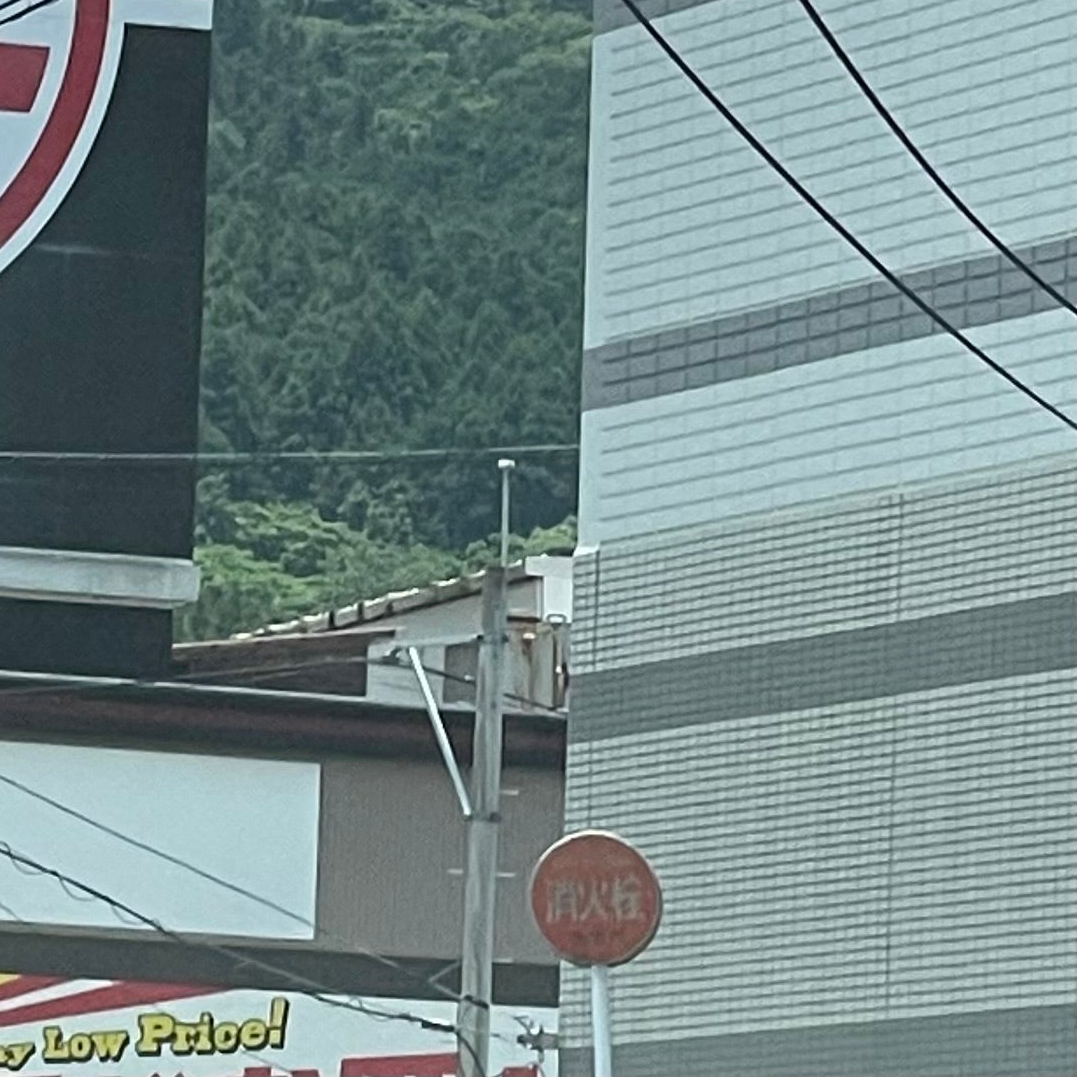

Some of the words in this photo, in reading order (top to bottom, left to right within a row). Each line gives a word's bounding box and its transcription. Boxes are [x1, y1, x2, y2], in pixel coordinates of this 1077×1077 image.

[544, 874, 646, 924] 消火栓
[42, 1026, 130, 1065] Low
[136, 996, 290, 1057] Price!
